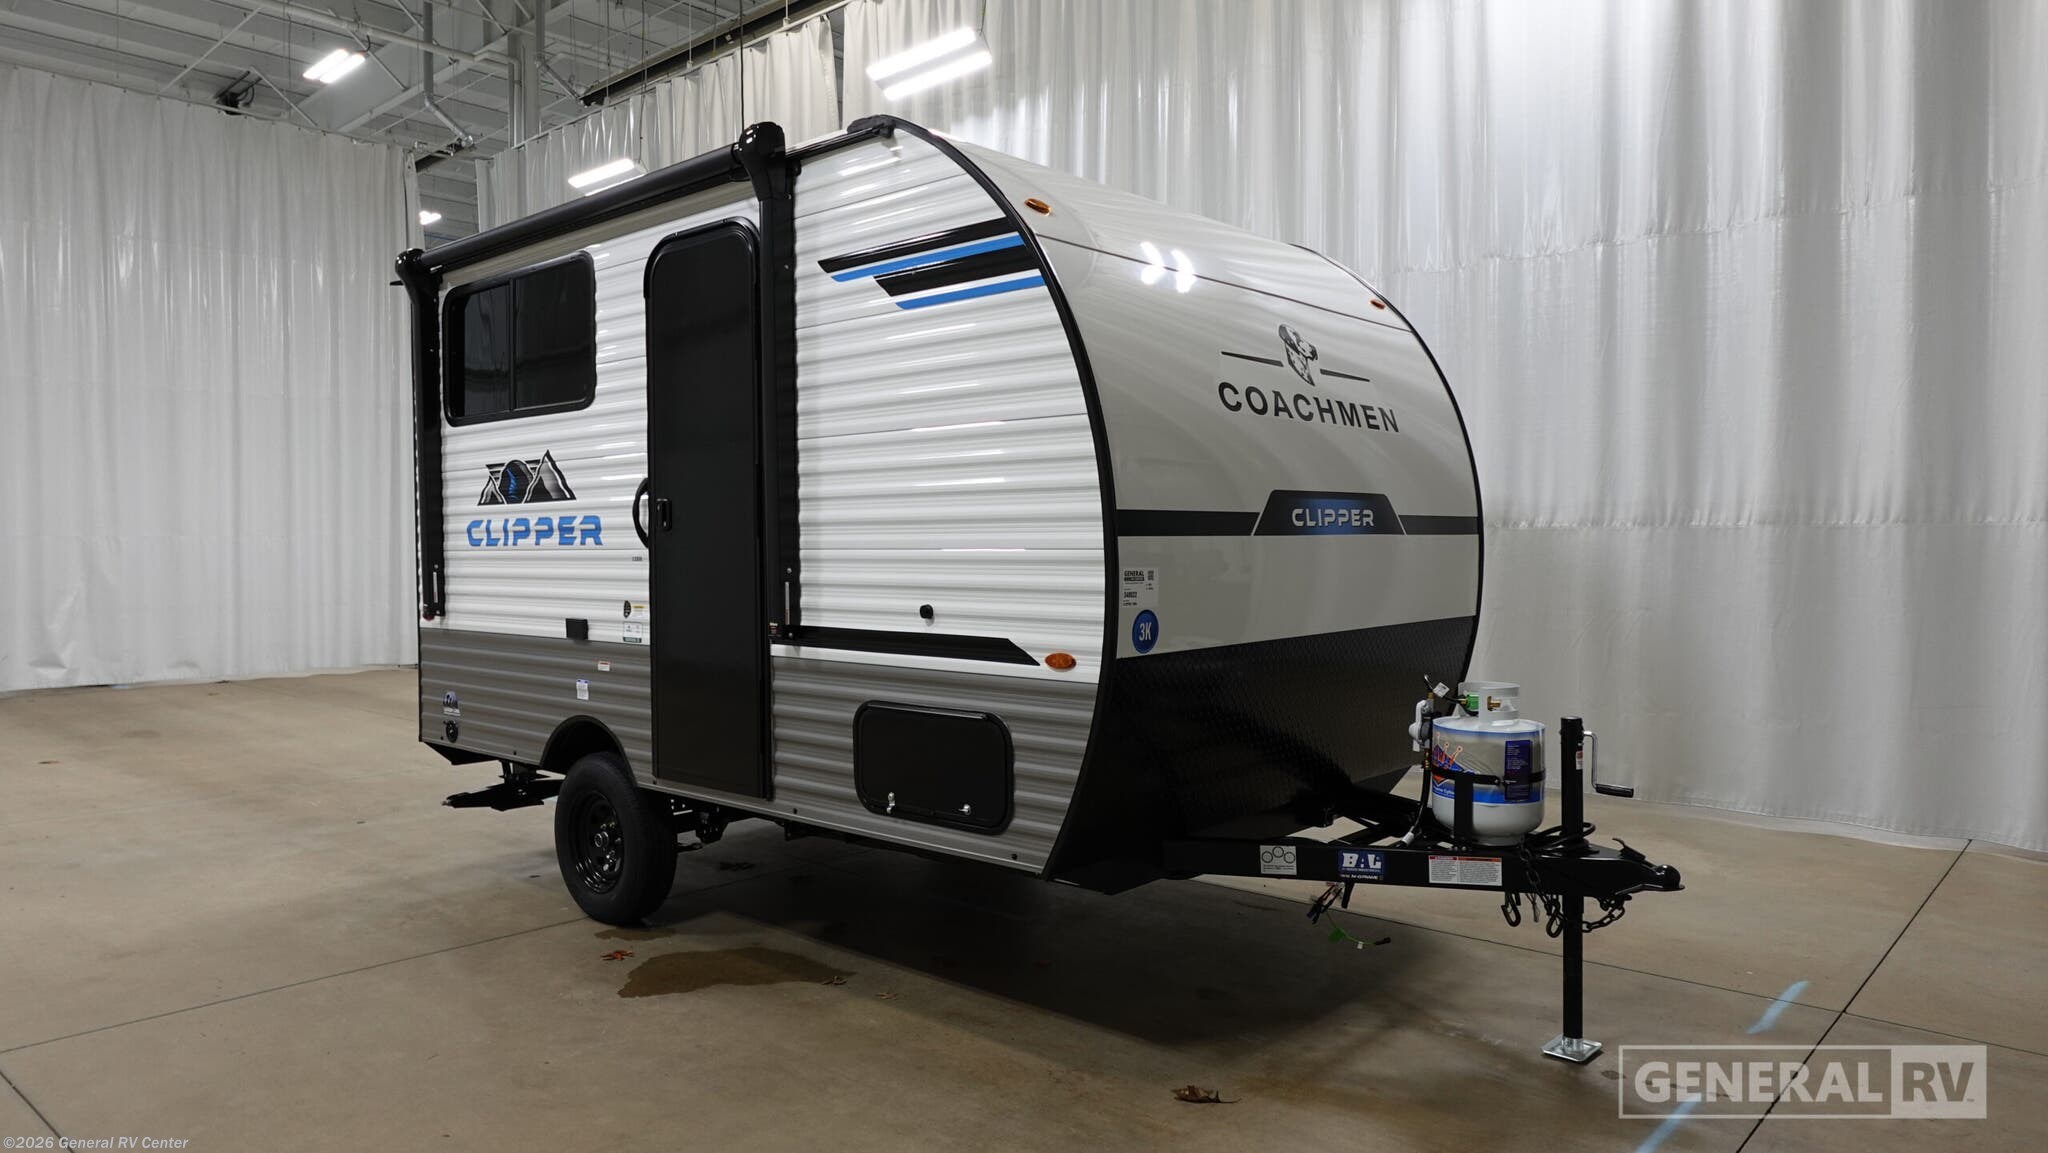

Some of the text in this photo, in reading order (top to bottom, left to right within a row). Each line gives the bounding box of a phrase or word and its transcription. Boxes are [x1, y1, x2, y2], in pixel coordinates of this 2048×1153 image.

[1218, 381, 1399, 432] COACHMEN
[1291, 508, 1375, 527] CLIPPER
[466, 515, 603, 547] CLIPPER
[1138, 622, 1152, 640] 3K
